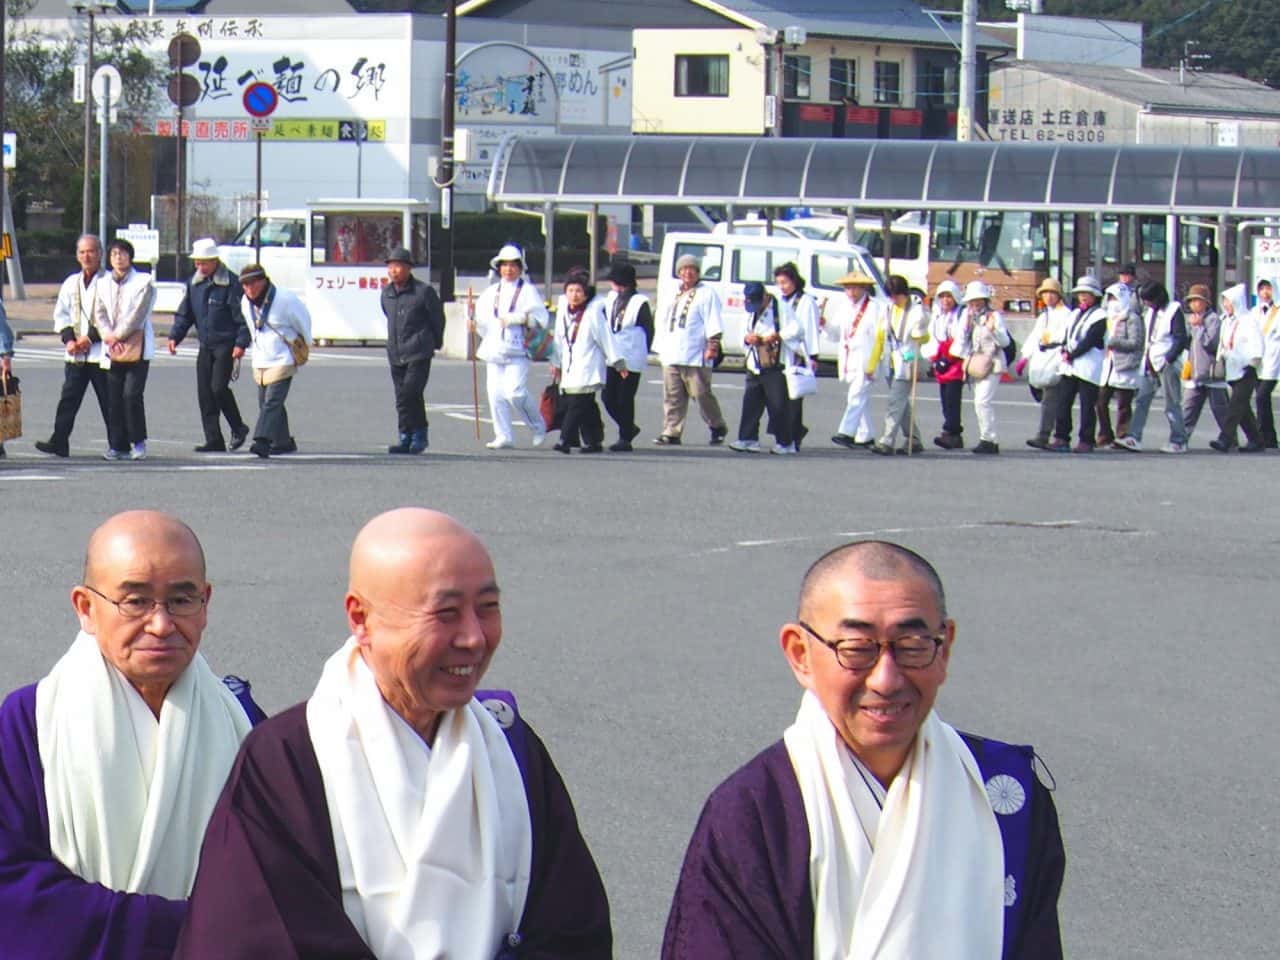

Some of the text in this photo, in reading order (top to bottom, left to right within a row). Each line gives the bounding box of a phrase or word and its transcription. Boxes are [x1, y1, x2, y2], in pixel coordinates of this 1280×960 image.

[172, 55, 387, 102] 延べ麺の郷
[1041, 108, 1106, 126] 土庄倉庫
[999, 129, 1105, 142] TEL 62-6309
